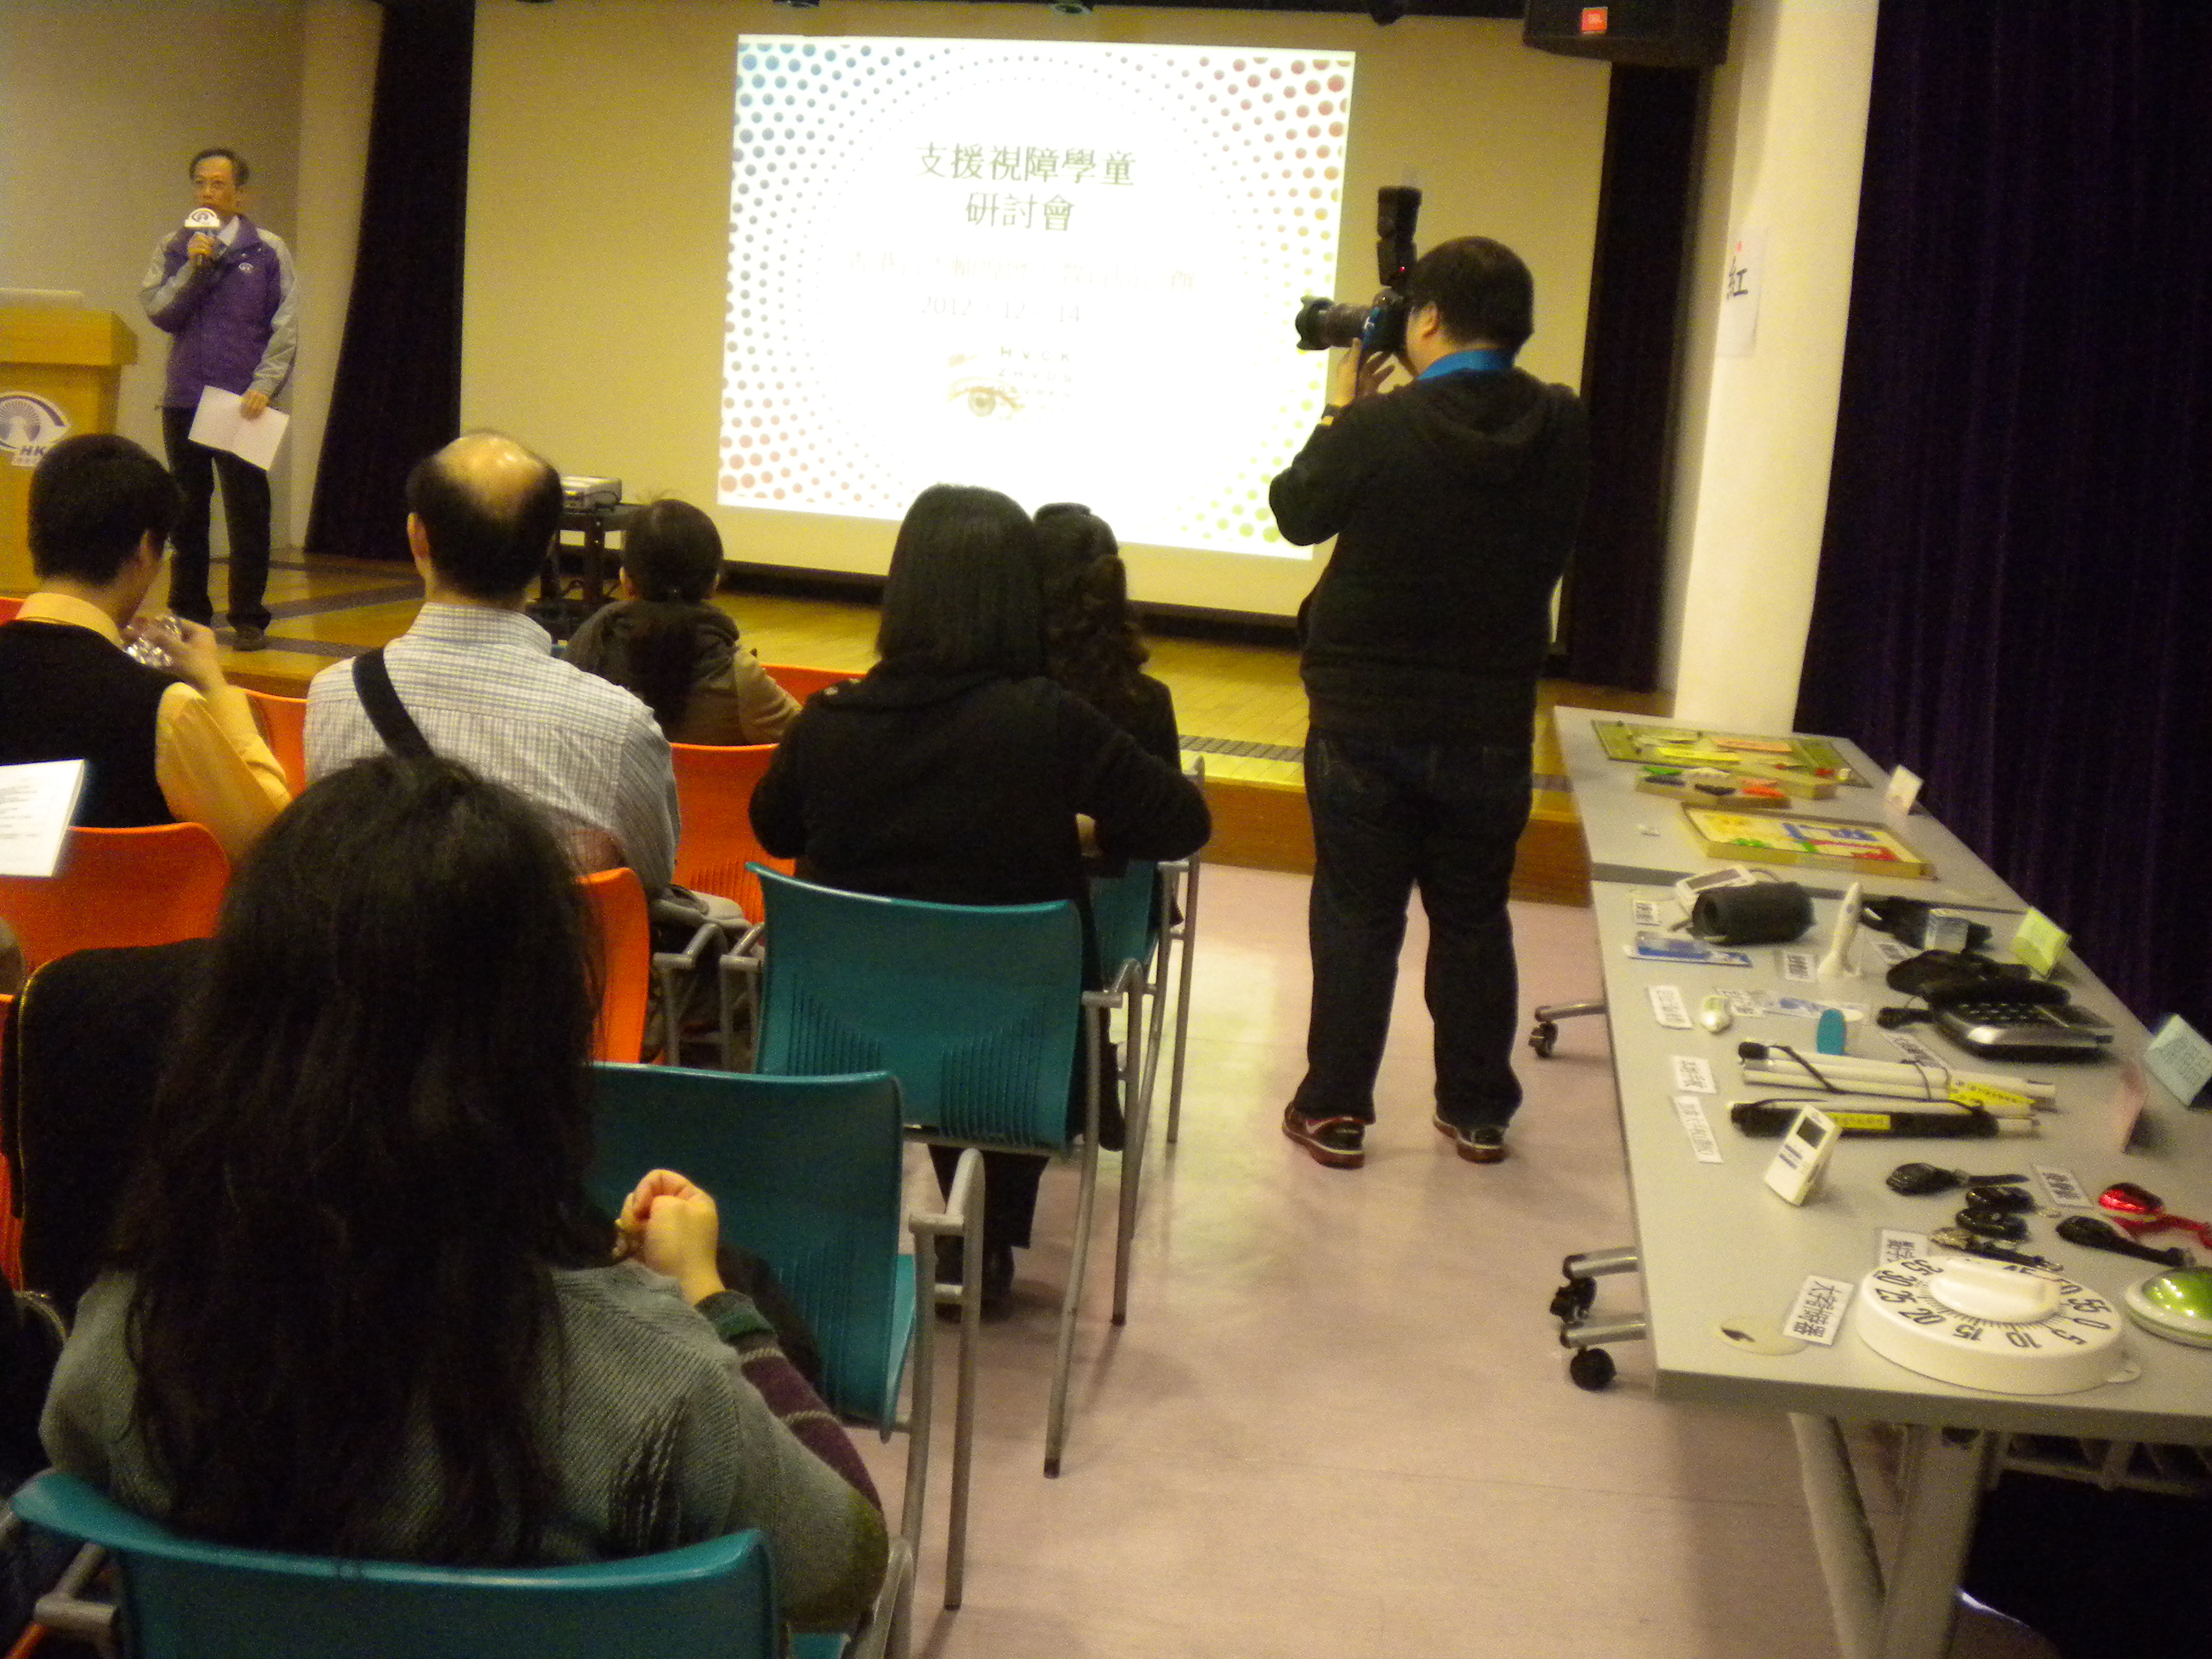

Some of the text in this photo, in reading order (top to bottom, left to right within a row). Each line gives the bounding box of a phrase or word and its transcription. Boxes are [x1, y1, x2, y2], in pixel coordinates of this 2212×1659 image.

[916, 141, 1136, 186] 支援視障學童
[965, 192, 1076, 232] 研討會
[1899, 1308, 1946, 1324] 20
[1952, 1324, 1983, 1341] 15
[2006, 1332, 2042, 1349] 10
